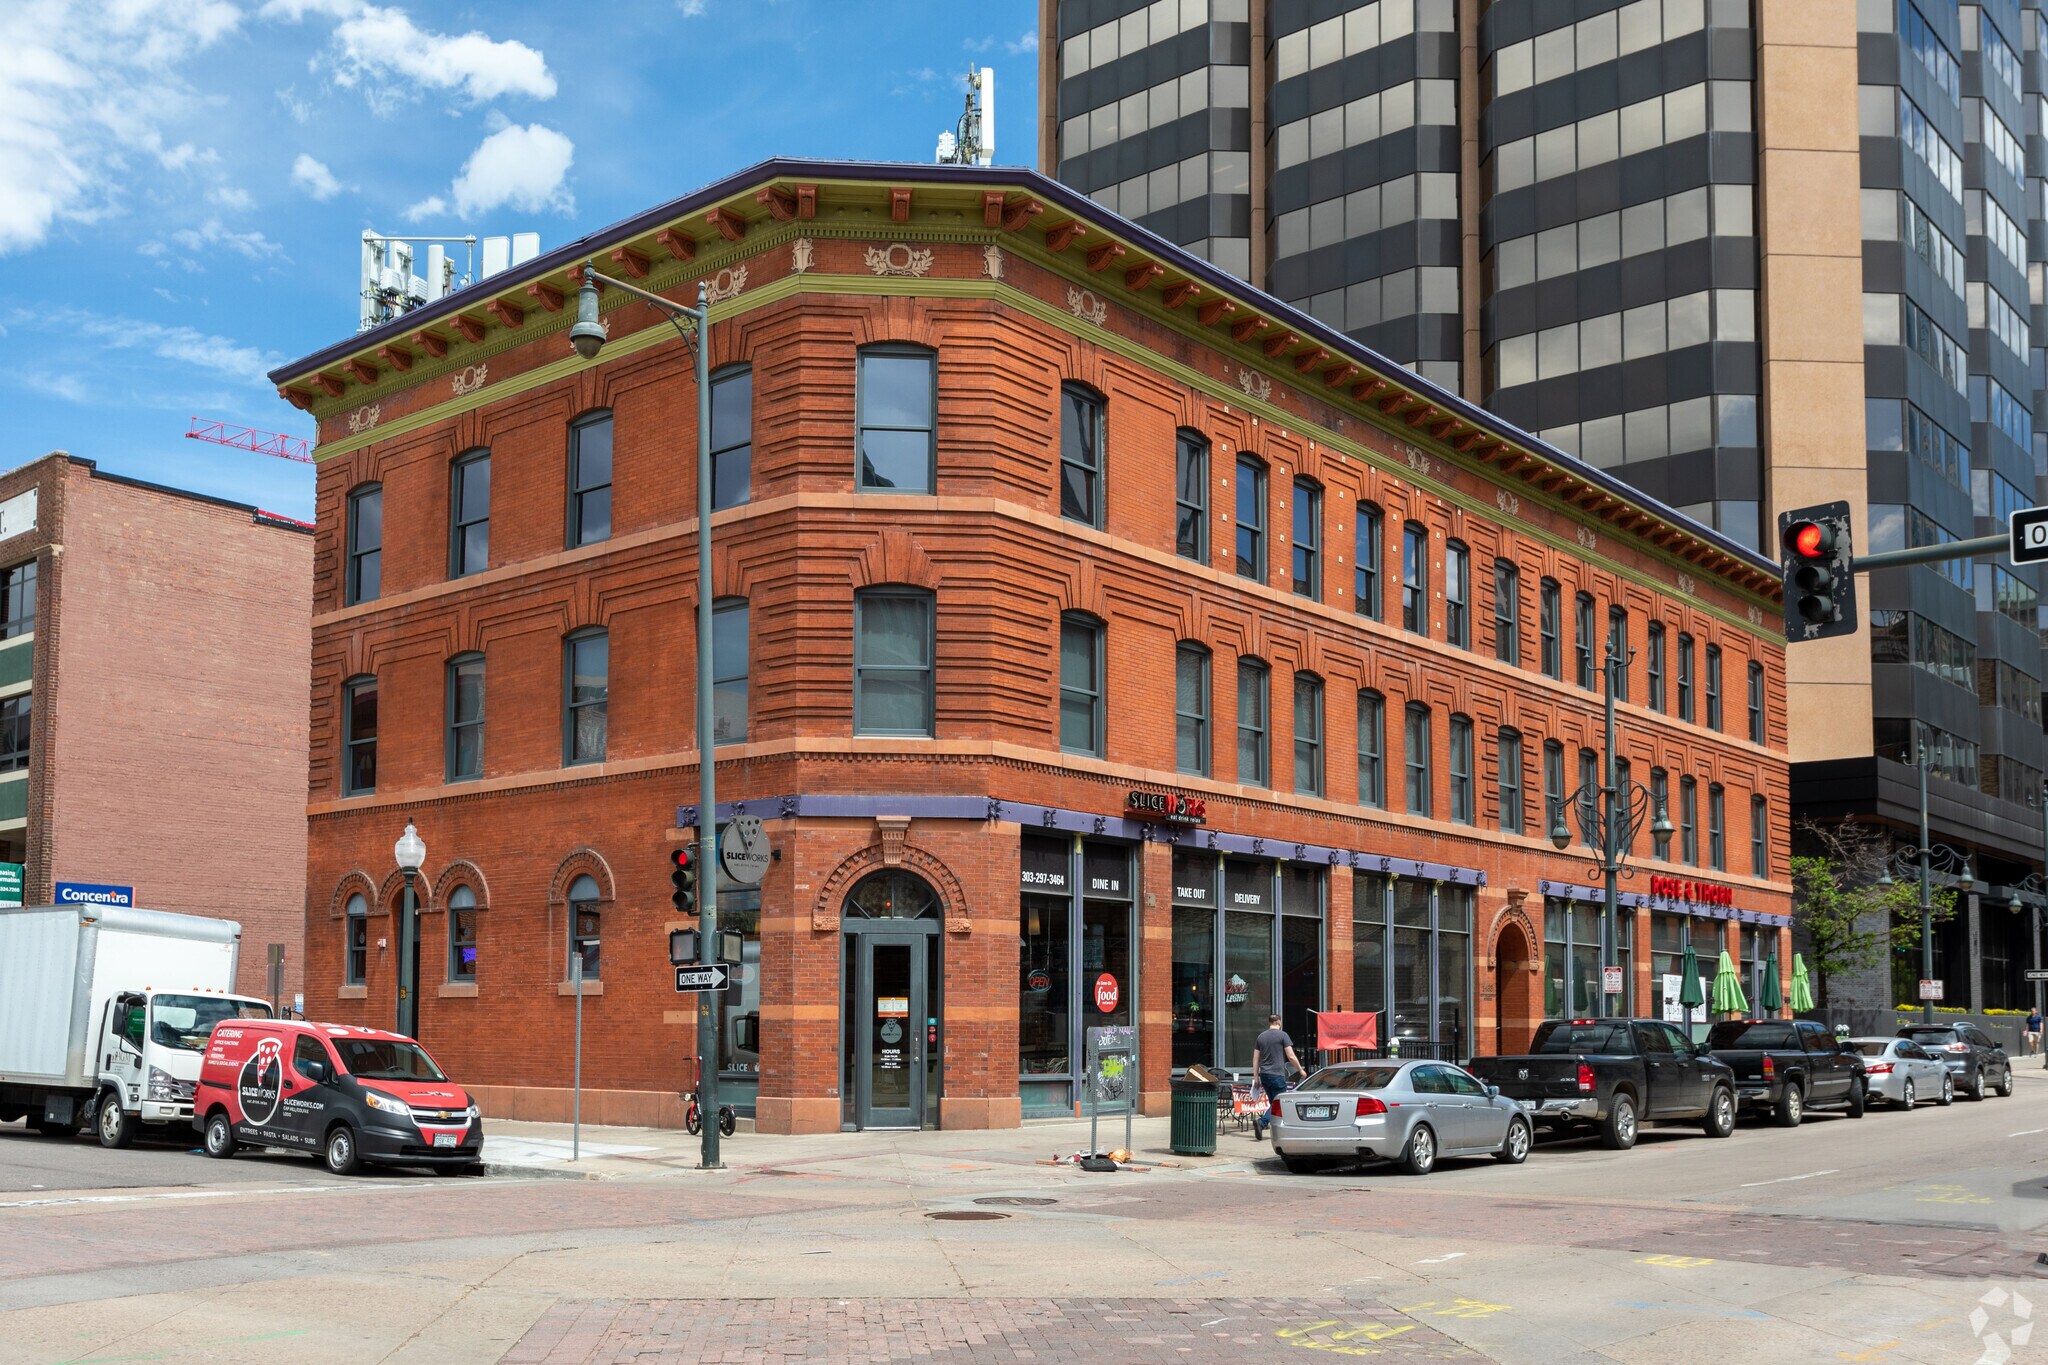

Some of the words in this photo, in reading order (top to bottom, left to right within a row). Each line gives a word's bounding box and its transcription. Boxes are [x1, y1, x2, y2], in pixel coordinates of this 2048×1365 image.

[726, 851, 769, 863] SLICEWORKS
[1021, 871, 1064, 886] 303-297-3464
[1092, 878, 1109, 890] DINE
[1111, 880, 1119, 891] IN
[62, 888, 129, 904] Concentra
[1177, 886, 1193, 898] TAKE
[1193, 888, 1206, 899] OUT
[1651, 875, 1683, 897] ROSE
[1684, 881, 1693, 899] &
[1695, 883, 1733, 905] THORN
[1234, 892, 1261, 905] DELIVERY
[681, 973, 696, 984] ONE
[697, 972, 713, 982] WAY
[1029, 977, 1049, 988] OPEN
[1096, 986, 1118, 1006] food
[216, 1029, 243, 1039] CATERING
[241, 1086, 276, 1100] SLICEWORKS
[283, 1098, 324, 1110] SLICEWORKS.COM
[240, 1127, 258, 1137] ENTREES
[263, 1130, 277, 1139] PASTA
[281, 1133, 299, 1143] SALADS
[304, 1137, 316, 1145] SUBS
